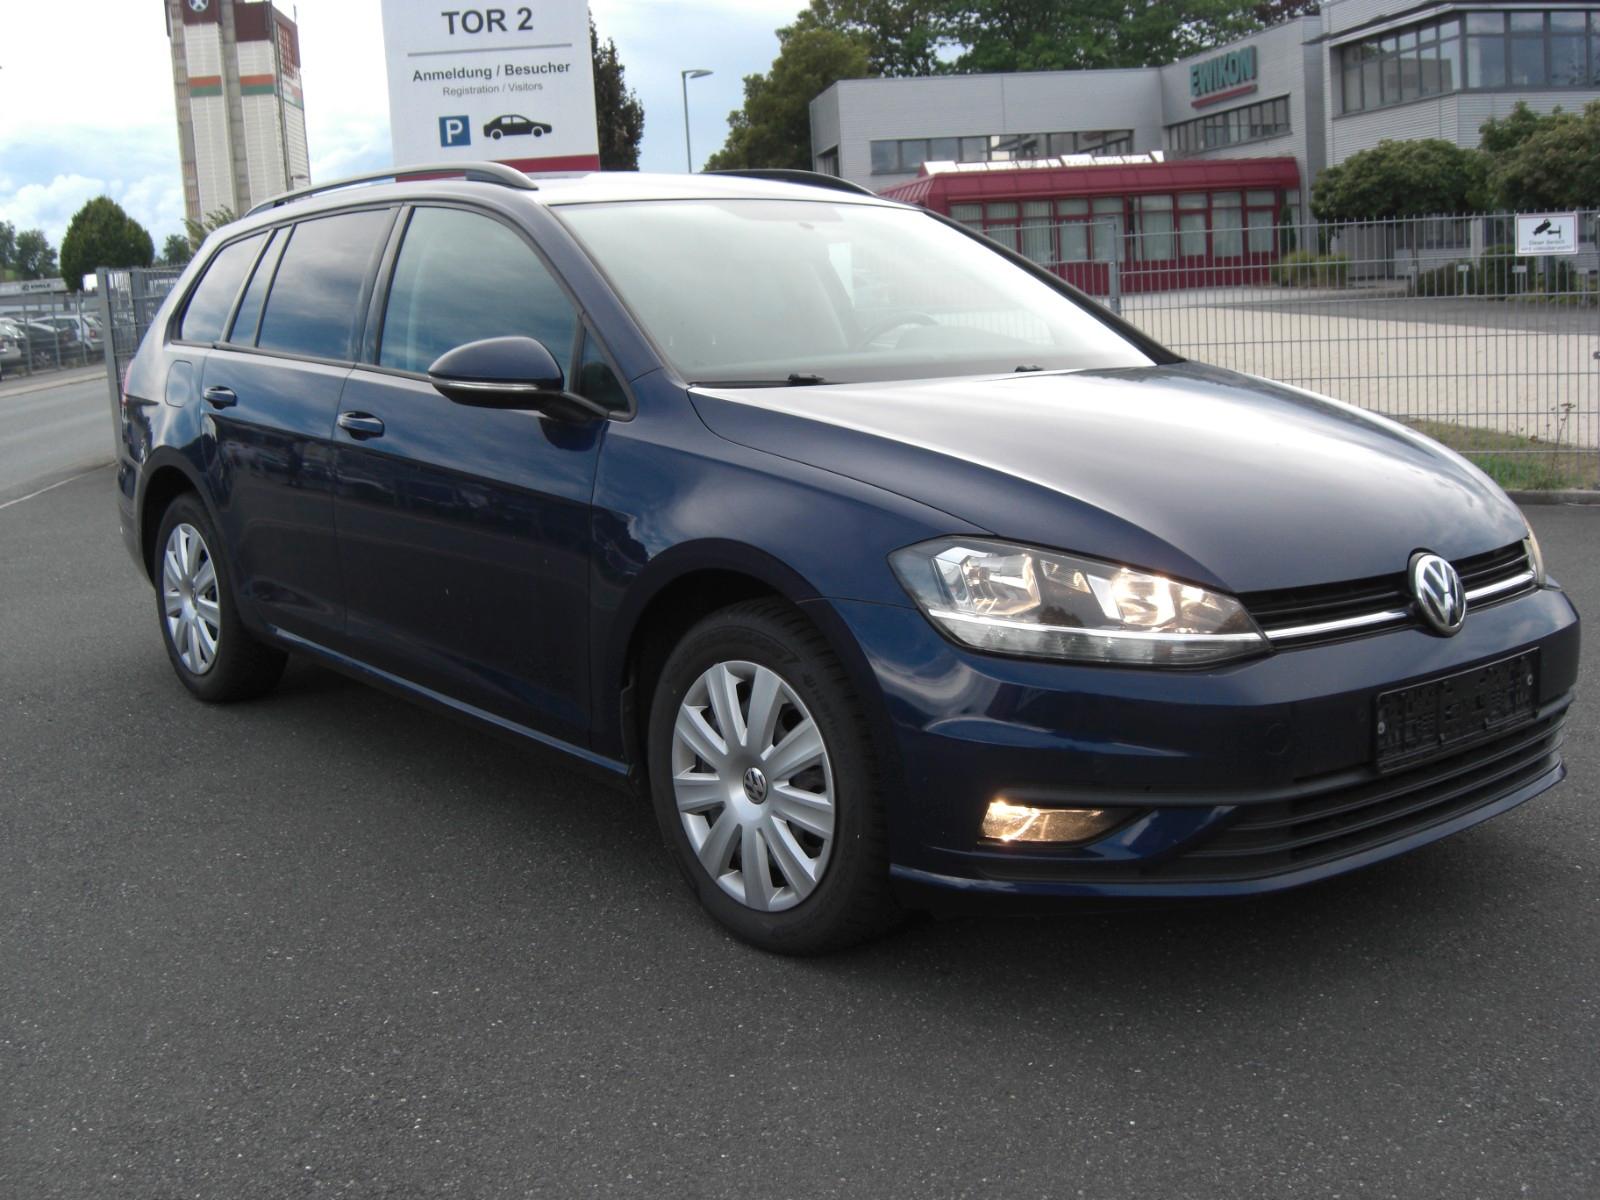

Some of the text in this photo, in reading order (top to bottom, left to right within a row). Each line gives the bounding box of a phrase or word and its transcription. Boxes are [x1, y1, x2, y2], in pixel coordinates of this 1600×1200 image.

[441, 7, 533, 35] TOR 2
[412, 61, 571, 82] Anmeldung / Besucher
[442, 82, 500, 98] Registration
[508, 81, 543, 92] Visitors
[445, 119, 464, 145] P
